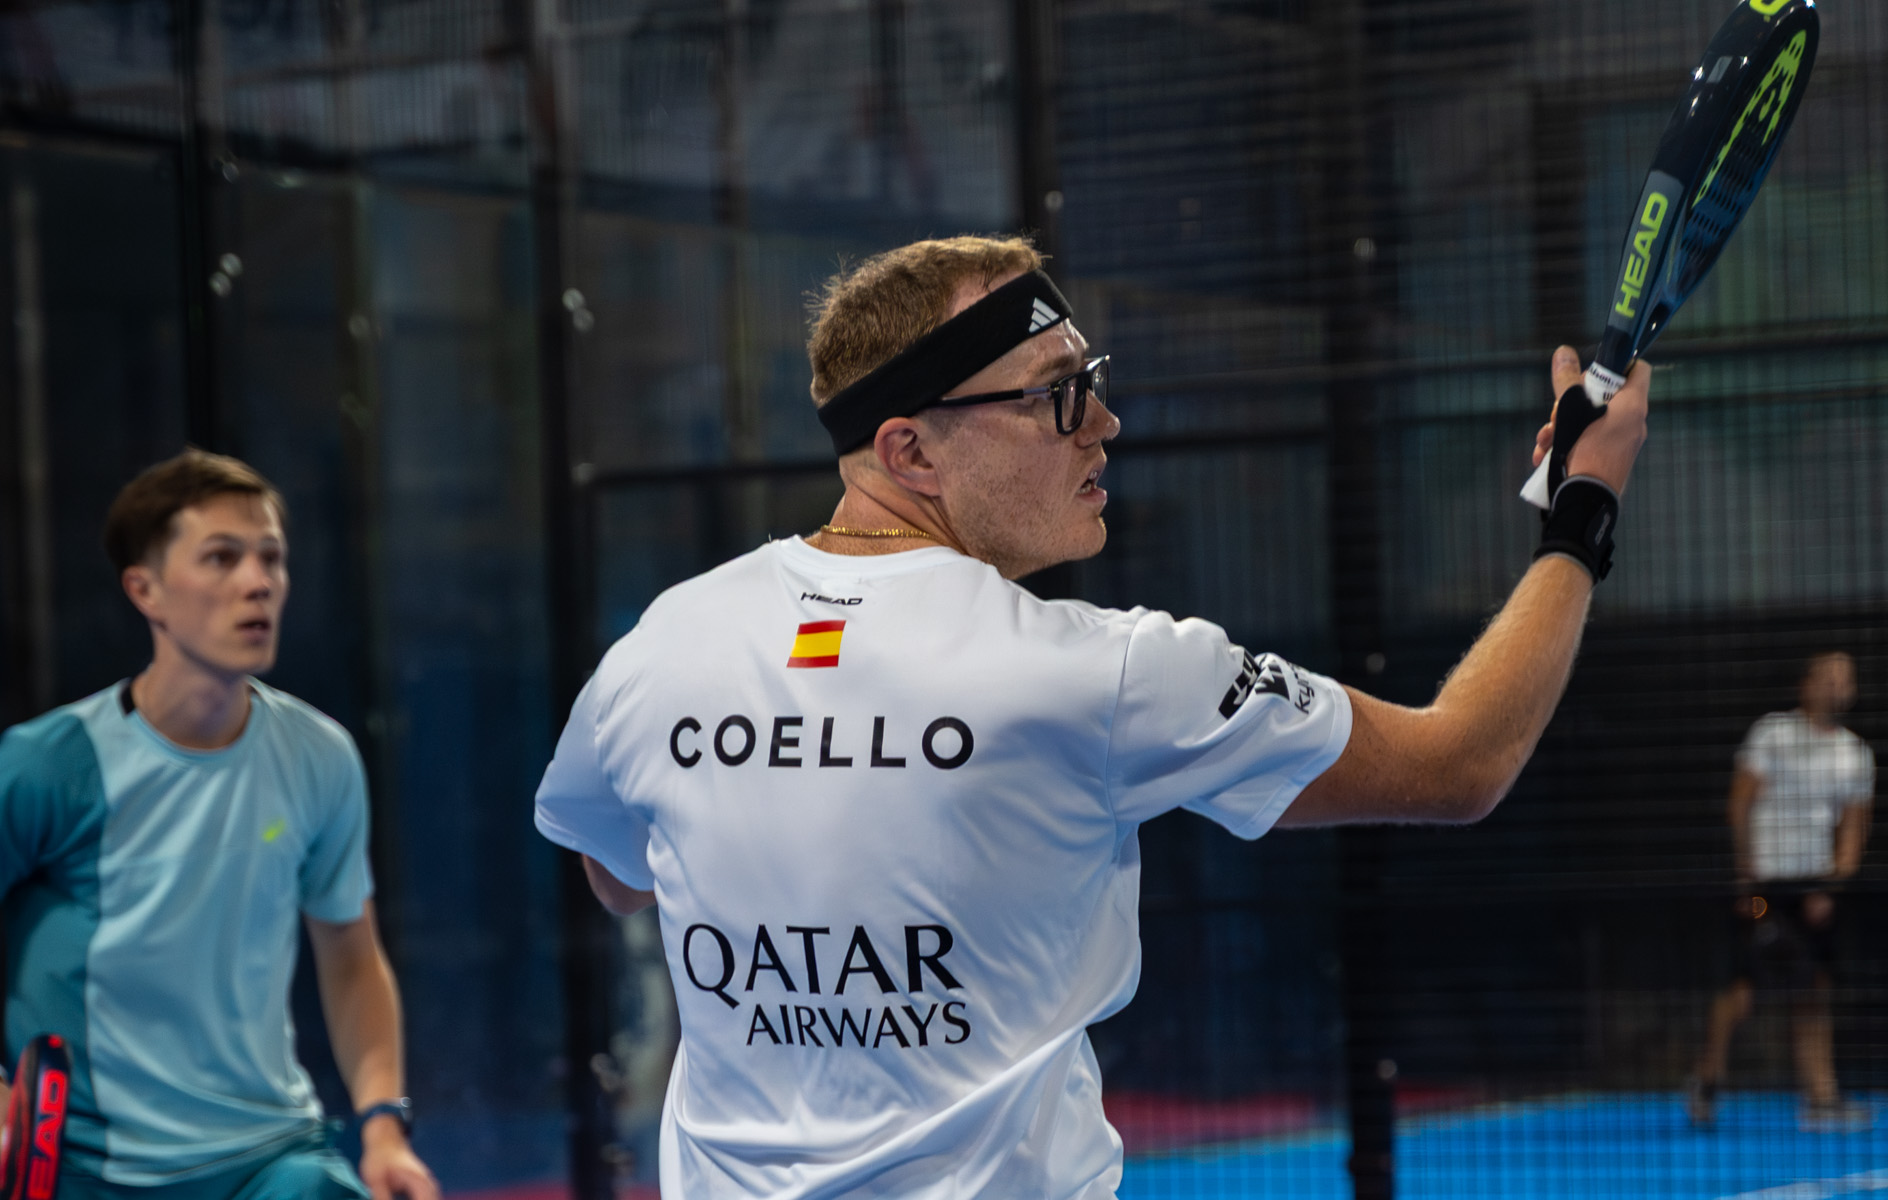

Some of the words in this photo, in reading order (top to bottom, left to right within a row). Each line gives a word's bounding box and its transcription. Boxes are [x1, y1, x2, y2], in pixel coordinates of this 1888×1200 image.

[1614, 191, 1668, 319] HEAD
[800, 592, 863, 605] HEAD
[670, 715, 974, 770] COELLO
[684, 922, 964, 1010] QATAR
[746, 1000, 972, 1048] AIRWAYS
